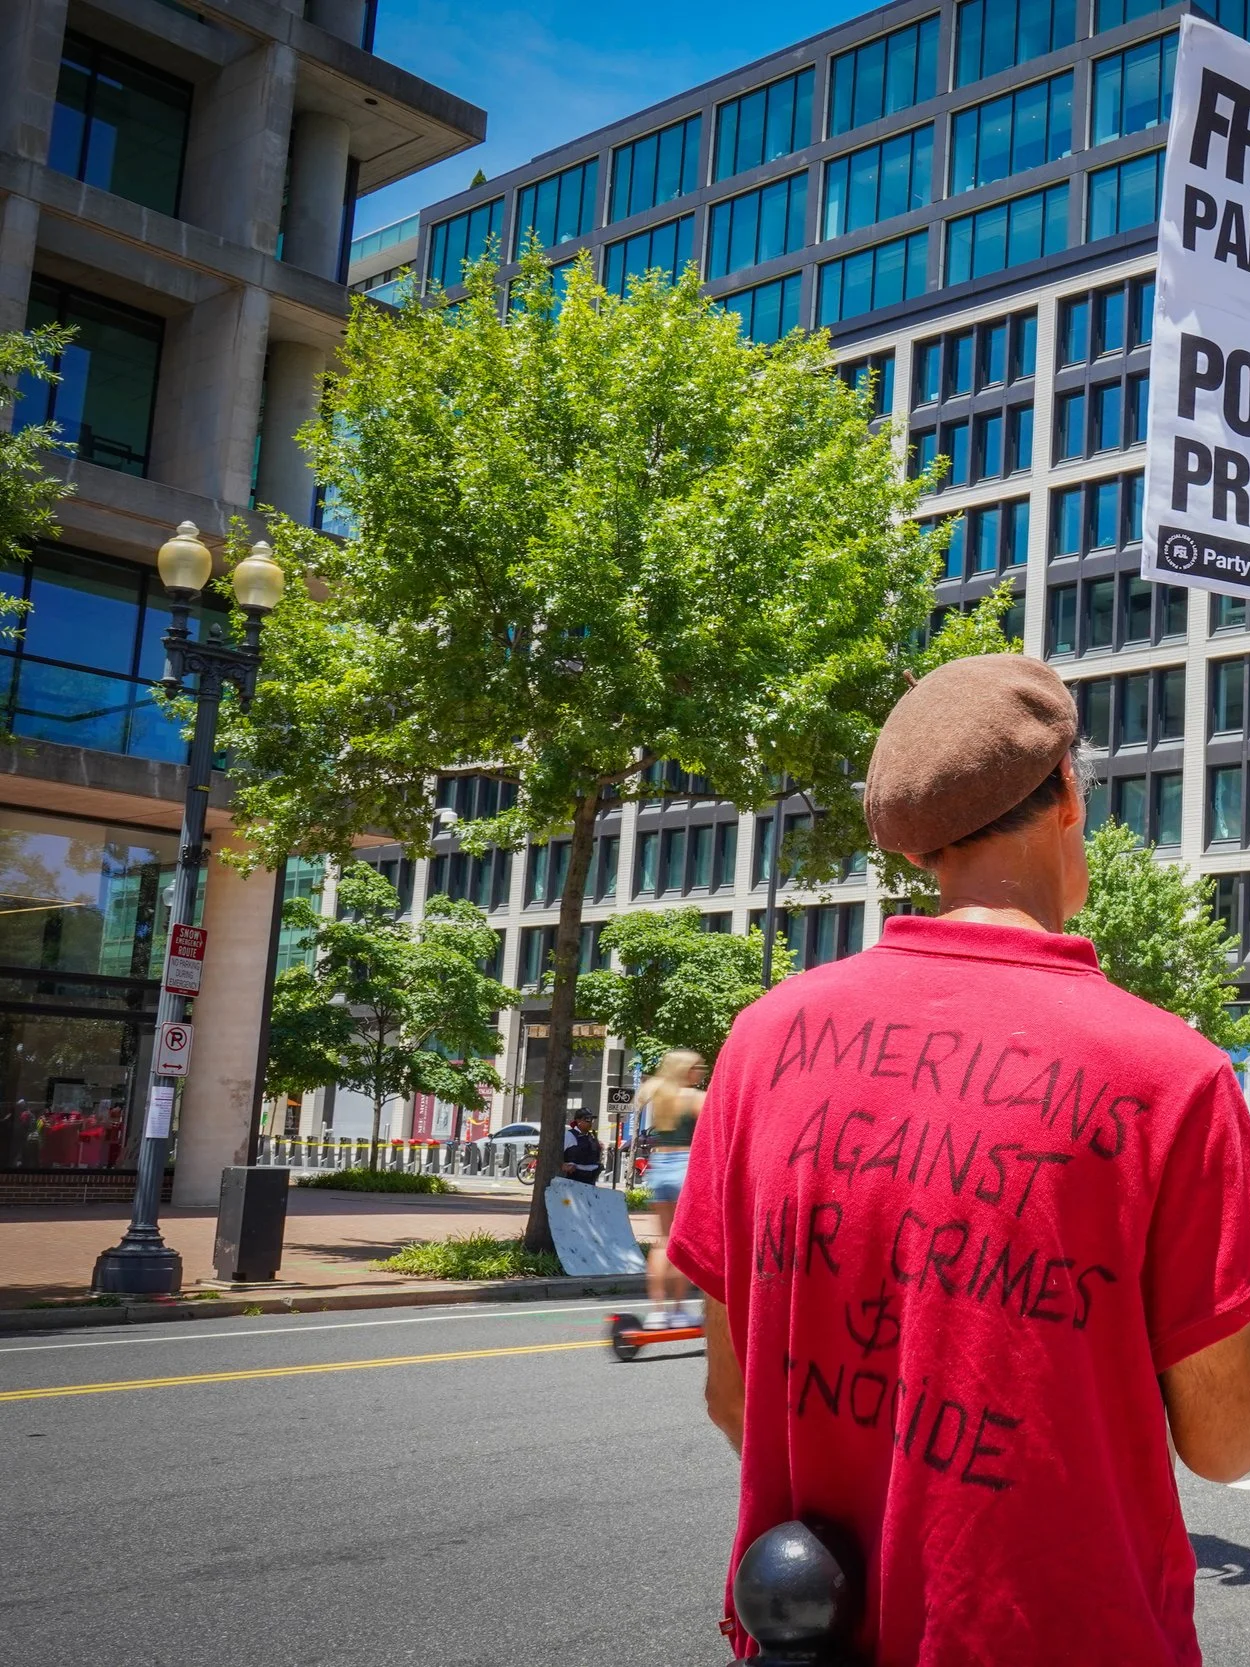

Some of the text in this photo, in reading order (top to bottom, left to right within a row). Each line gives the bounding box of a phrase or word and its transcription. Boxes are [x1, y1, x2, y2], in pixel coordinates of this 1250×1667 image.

[1203, 548, 1250, 577] Party
[175, 937, 203, 948] EMERGENCY
[180, 927, 200, 940] SNOW
[178, 946, 197, 958] ROUTE
[770, 1008, 1148, 1159] AMERICANS
[787, 1099, 1070, 1217] AGAINST
[756, 1195, 1116, 1331] WR CRIMES
